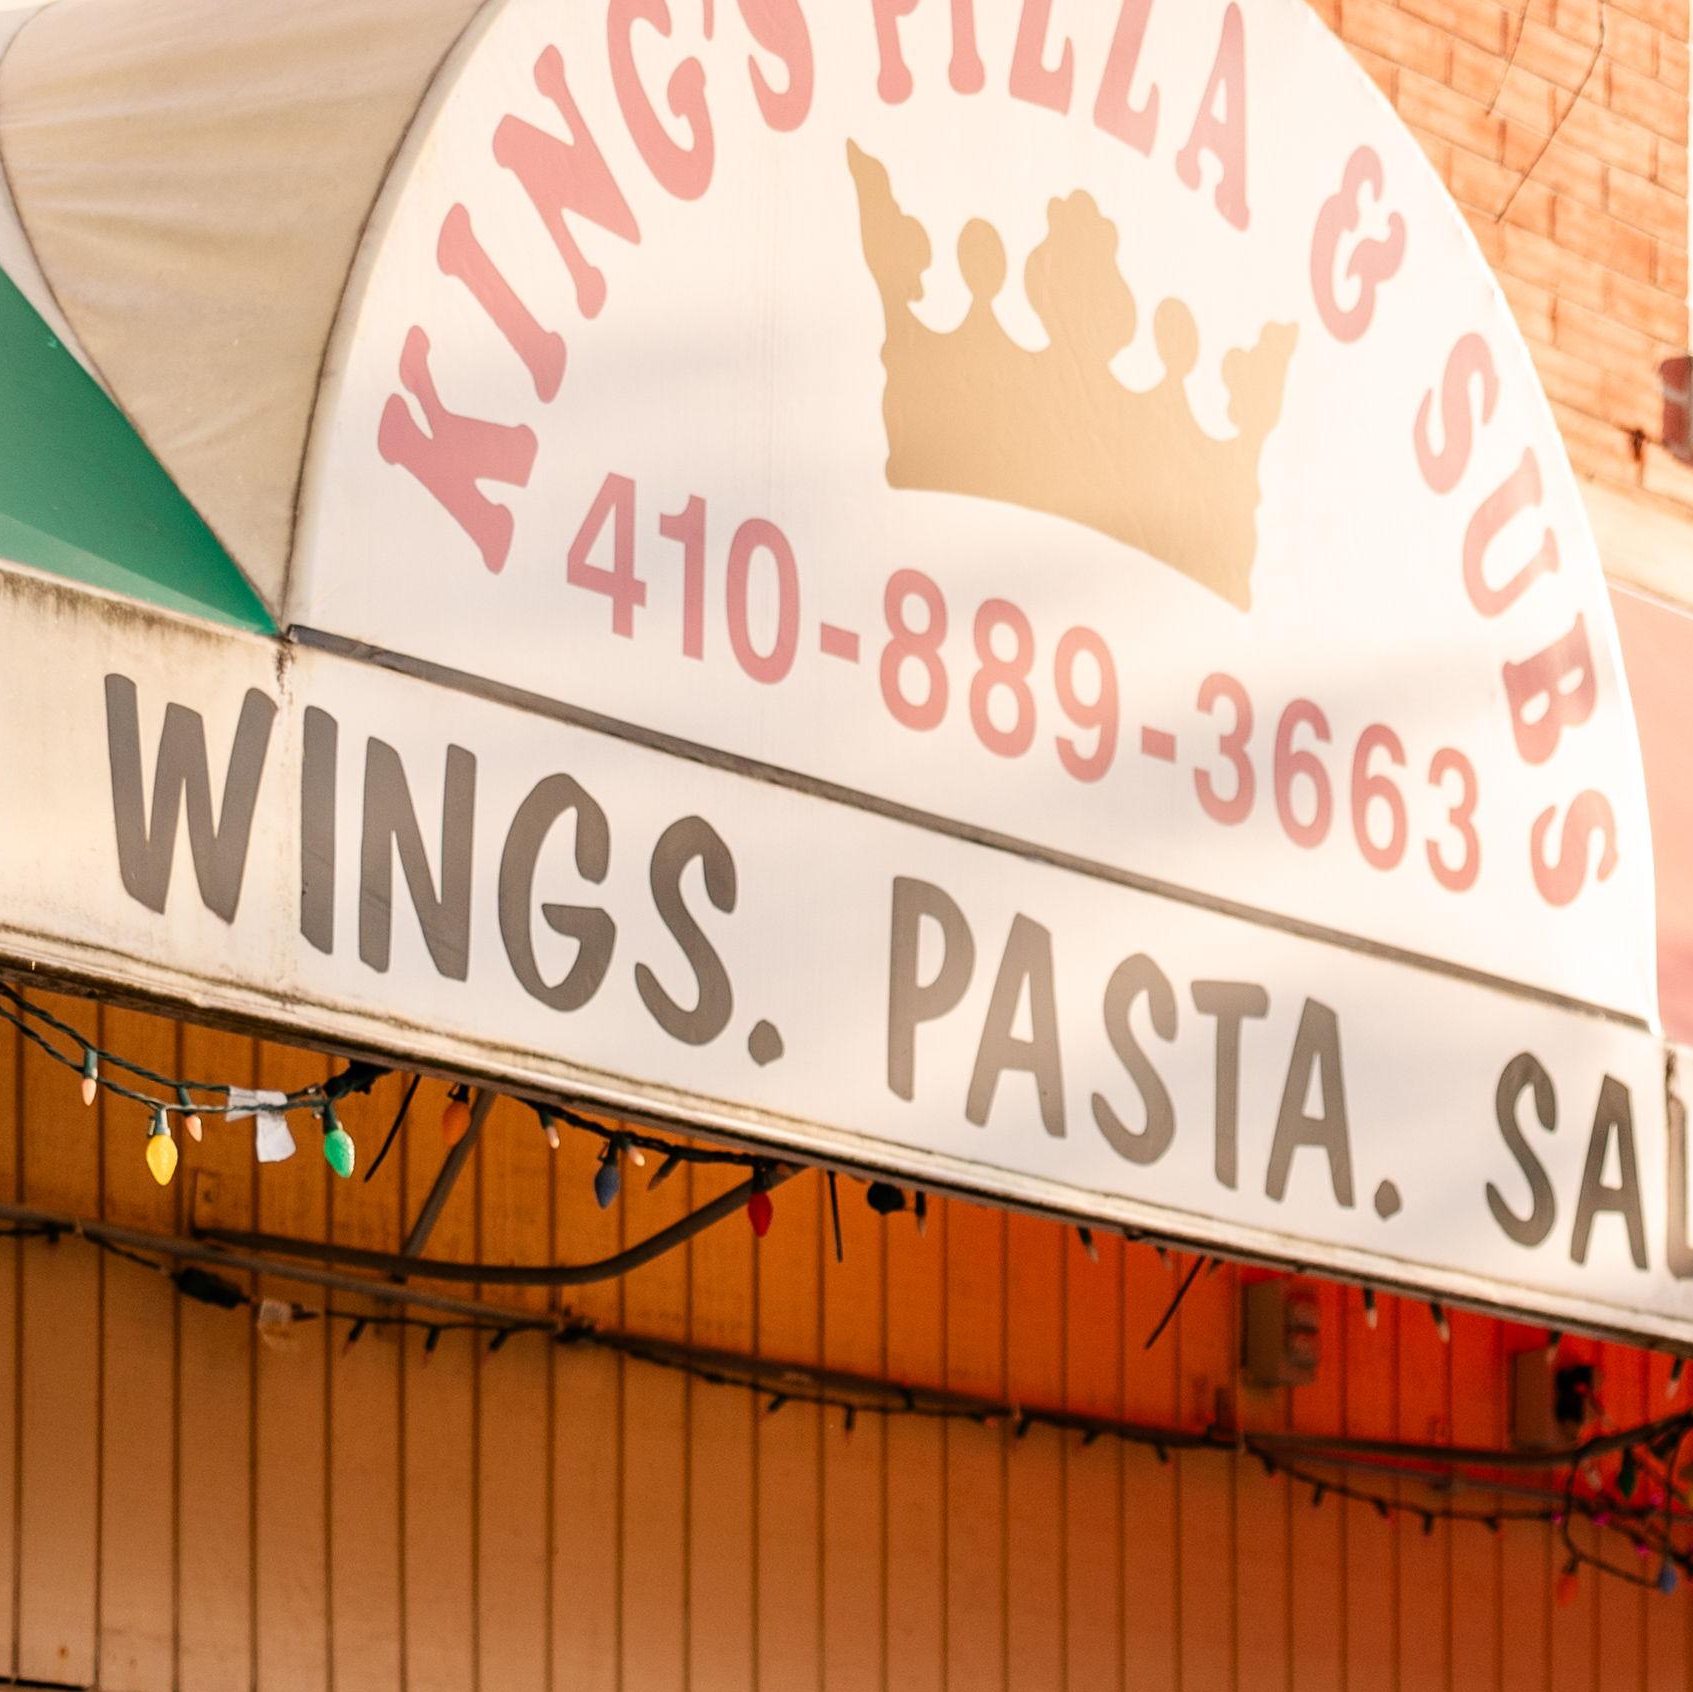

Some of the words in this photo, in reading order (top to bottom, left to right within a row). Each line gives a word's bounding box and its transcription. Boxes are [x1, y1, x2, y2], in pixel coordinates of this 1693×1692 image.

[566, 472, 1481, 892] 410-889-3663
[1311, 144, 1406, 343] &
[1413, 331, 1618, 908] SUBS
[105, 671, 785, 1068] WINGS.
[885, 874, 1403, 1223] PASTA.
